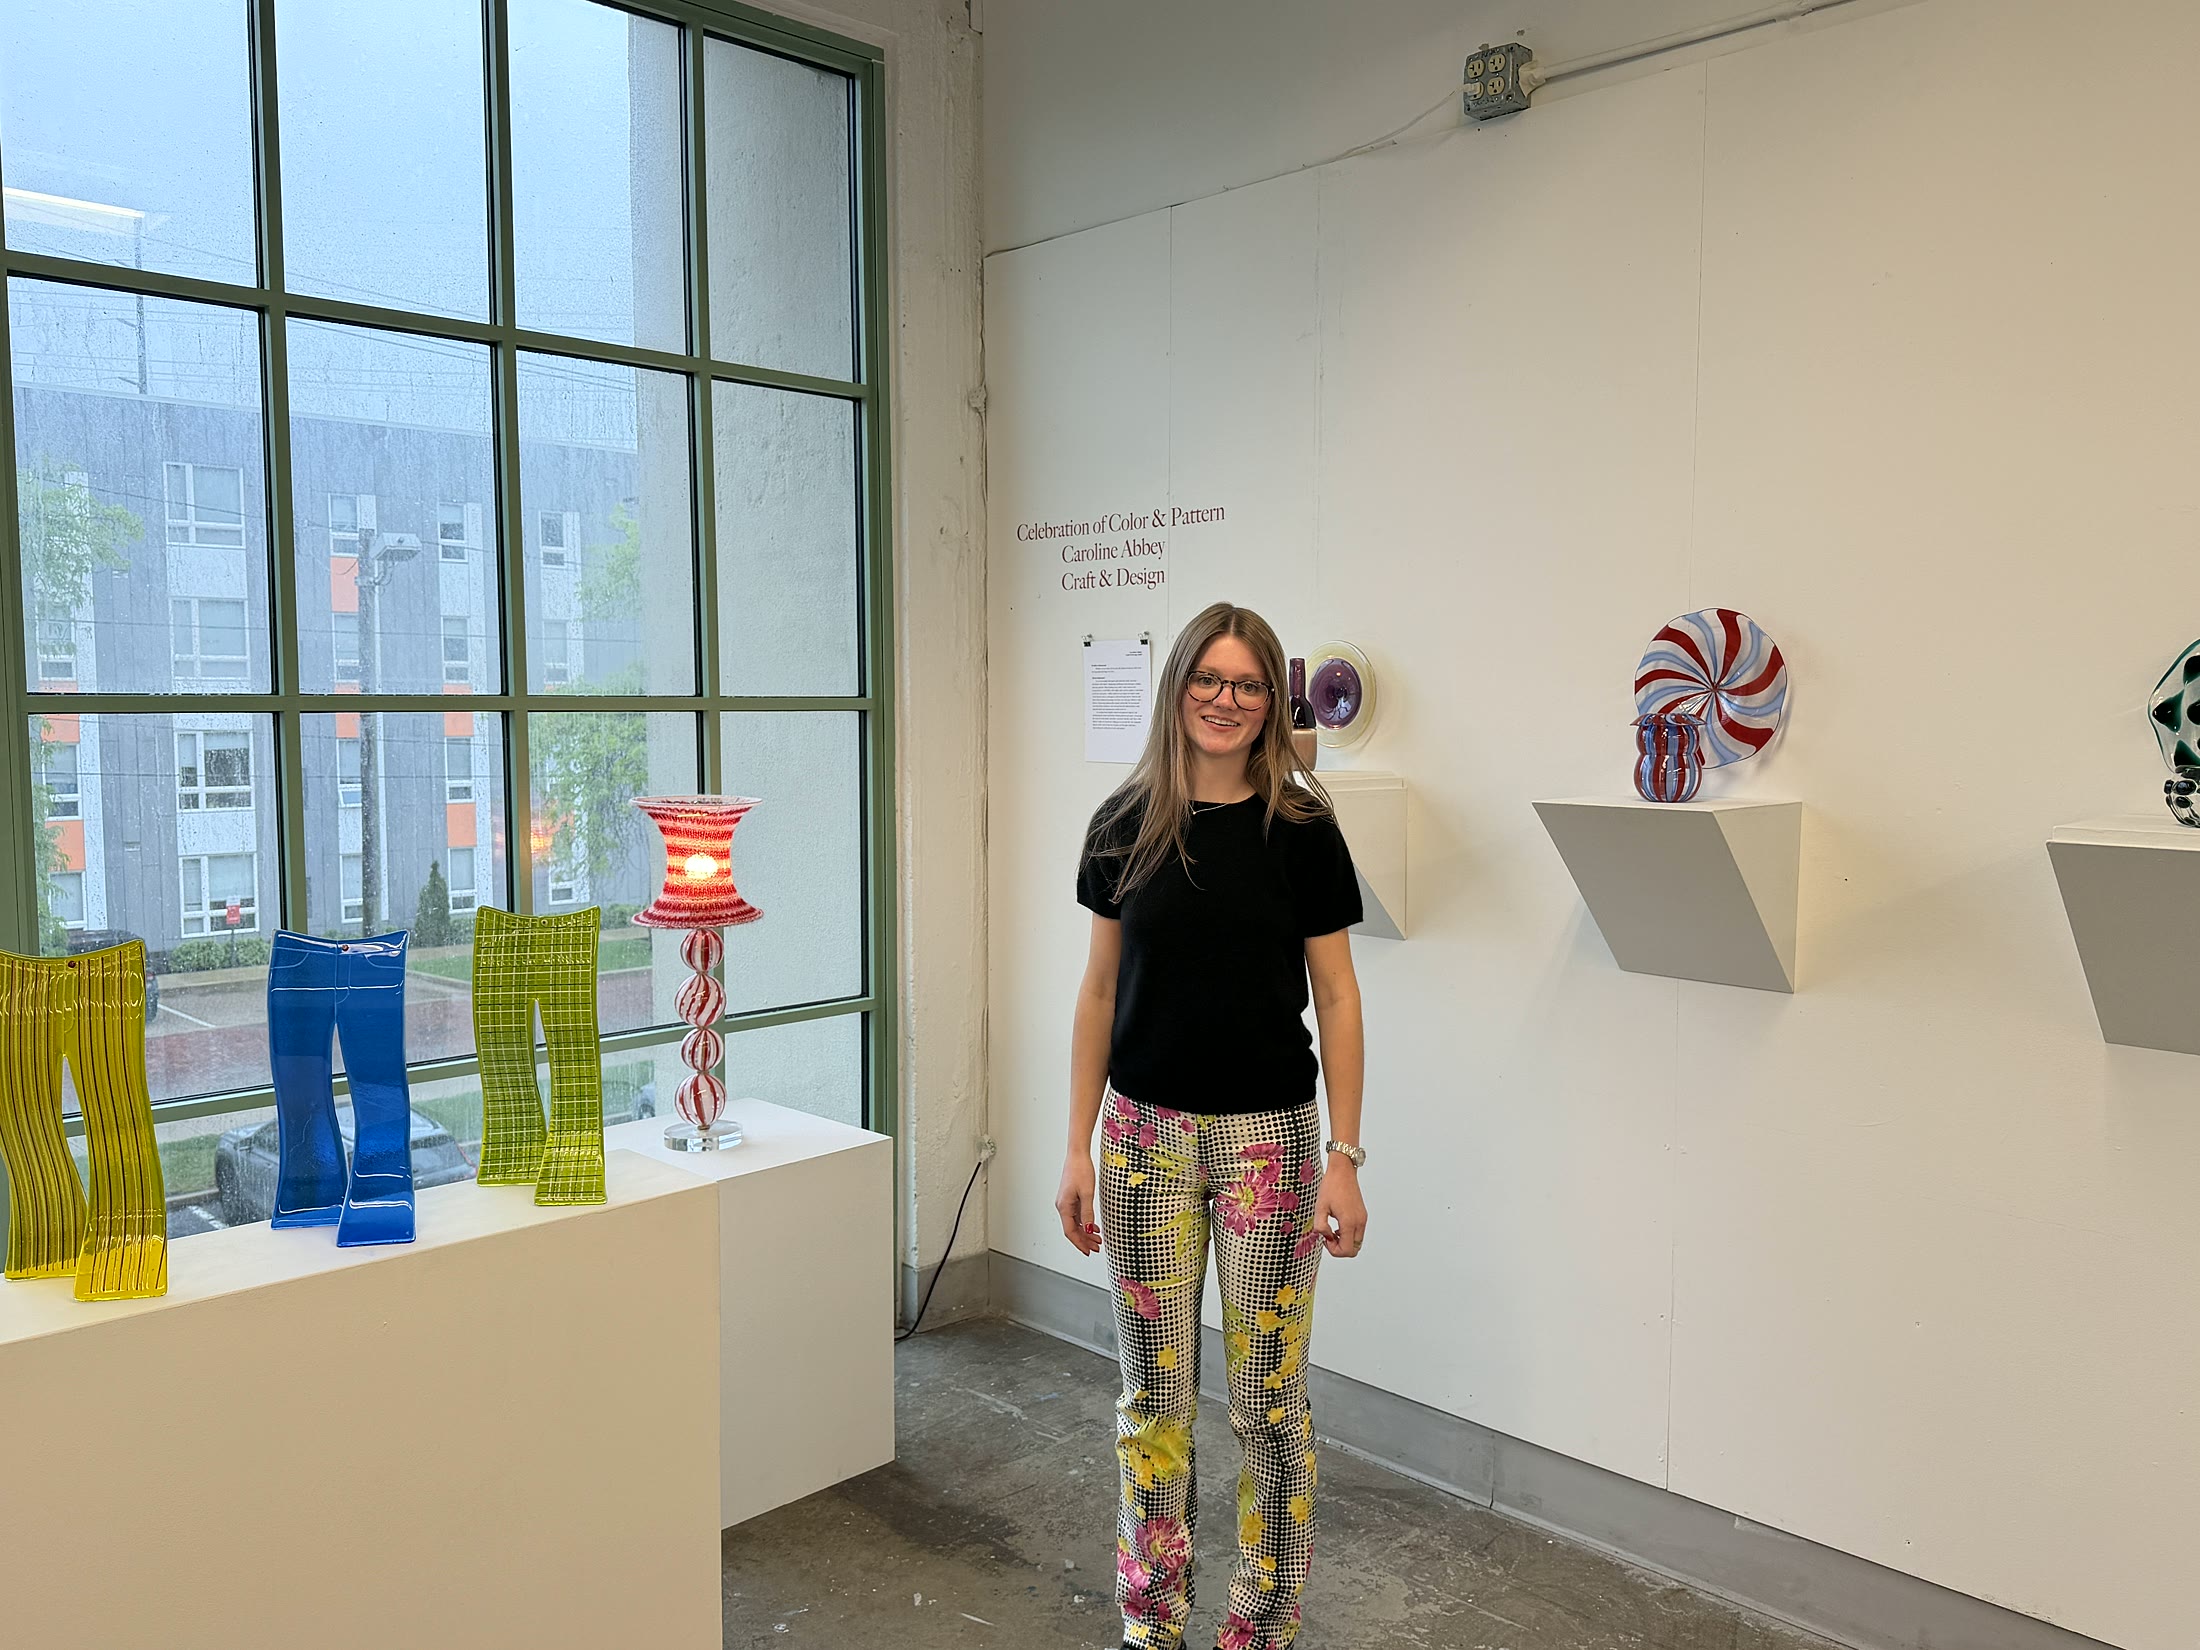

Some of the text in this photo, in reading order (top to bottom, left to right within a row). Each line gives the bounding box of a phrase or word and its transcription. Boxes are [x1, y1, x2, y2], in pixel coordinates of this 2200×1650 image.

[1017, 506, 1225, 541] Celebration of Color & Pattern
[1062, 538, 1165, 563] Caroline Abbey
[1062, 567, 1165, 591] Craft & Design
